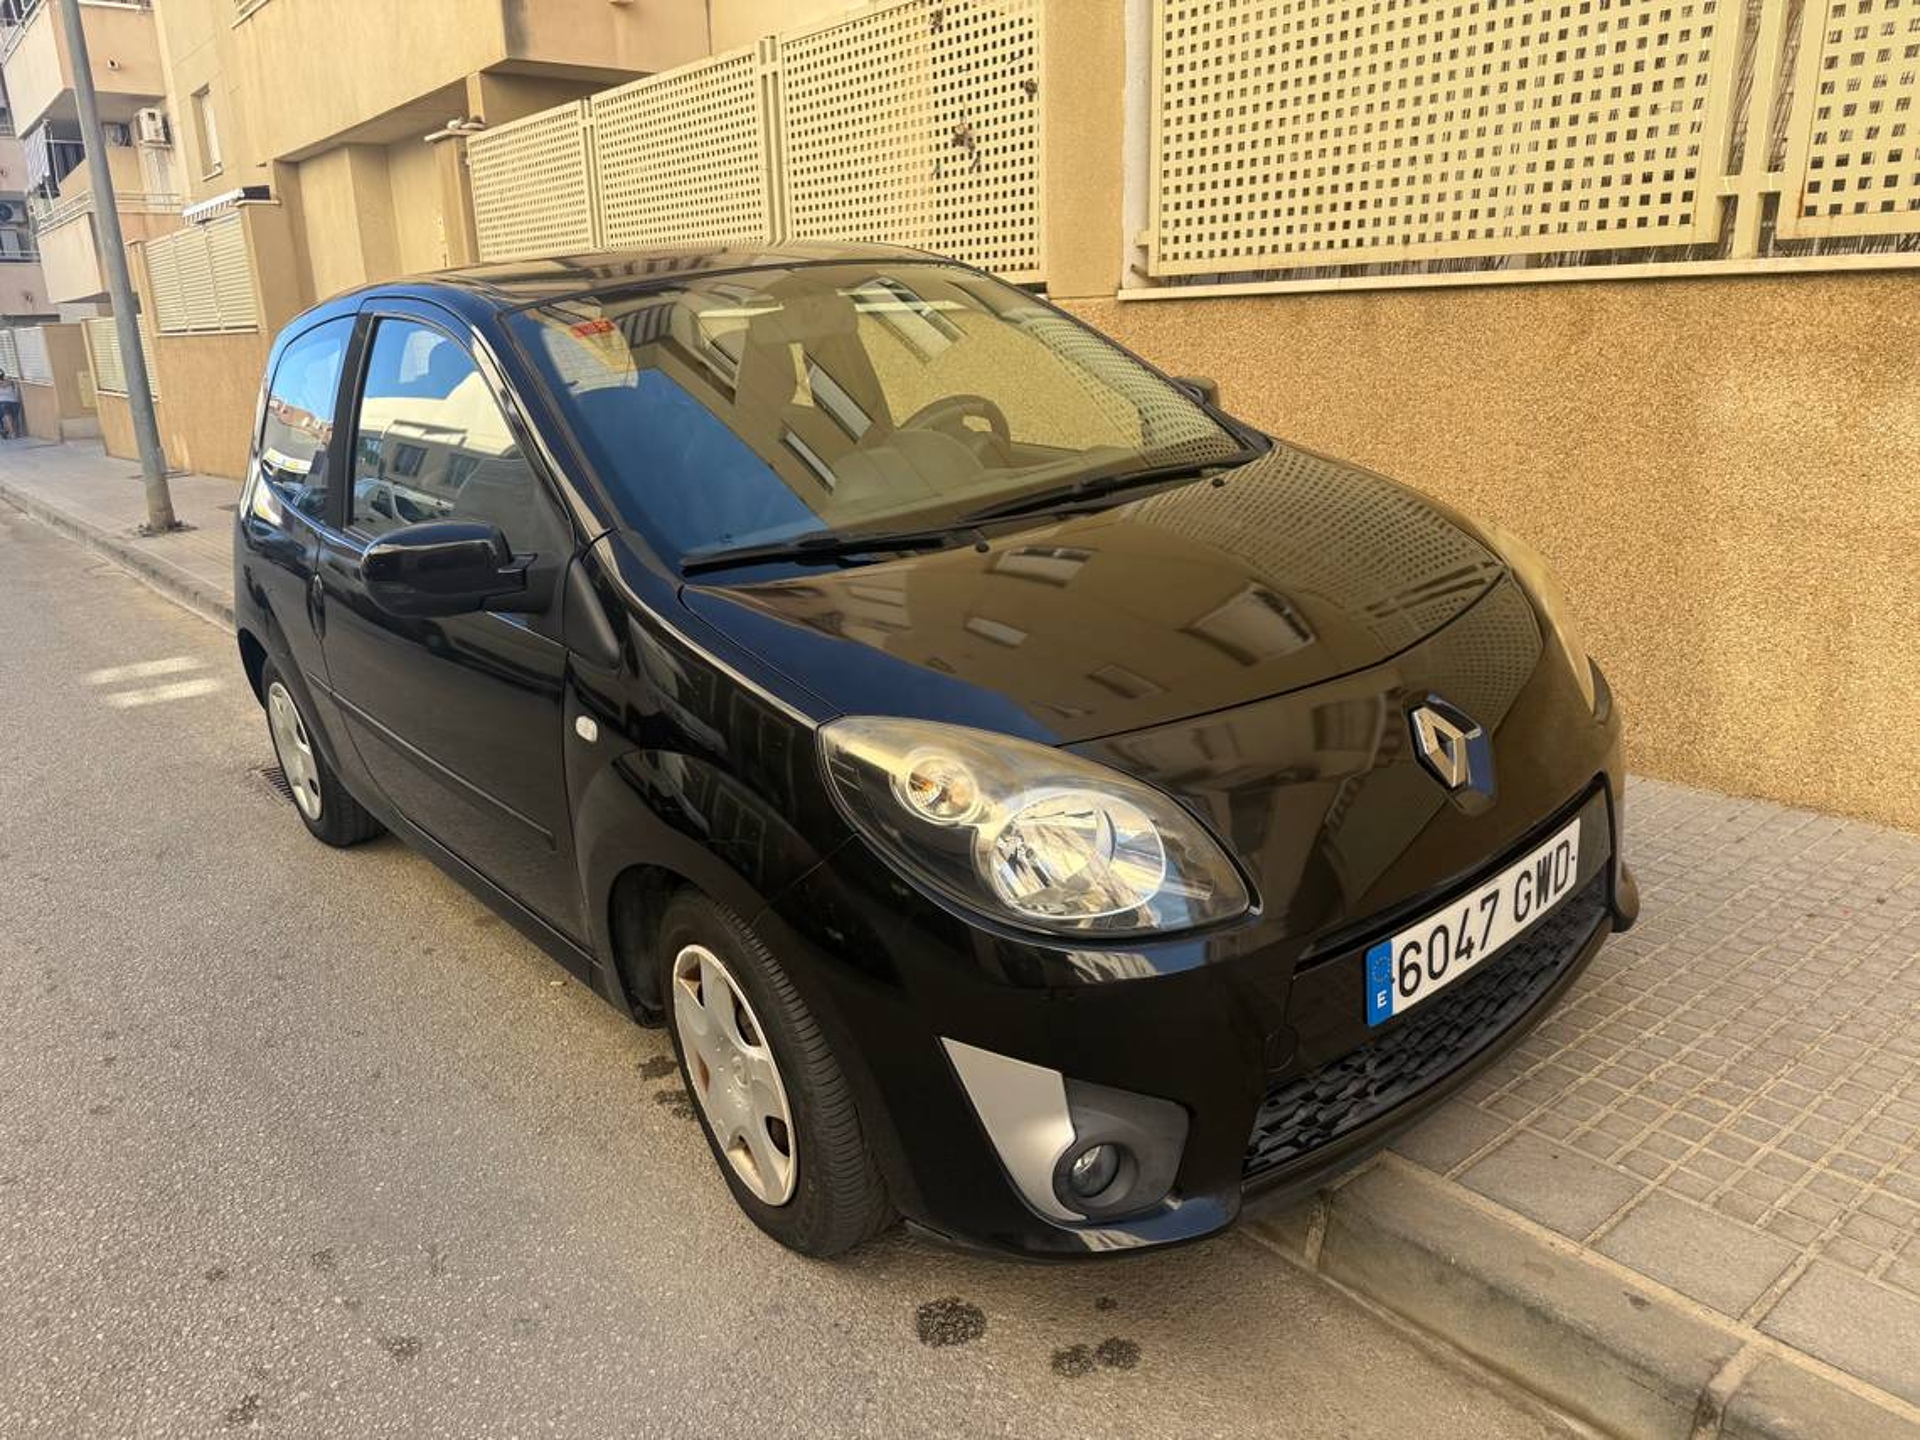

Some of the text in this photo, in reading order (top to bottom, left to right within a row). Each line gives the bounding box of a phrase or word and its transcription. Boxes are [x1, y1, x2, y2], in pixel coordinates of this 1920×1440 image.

[1399, 839, 1570, 998] 6047 GWD
[1376, 989, 1388, 1009] E
